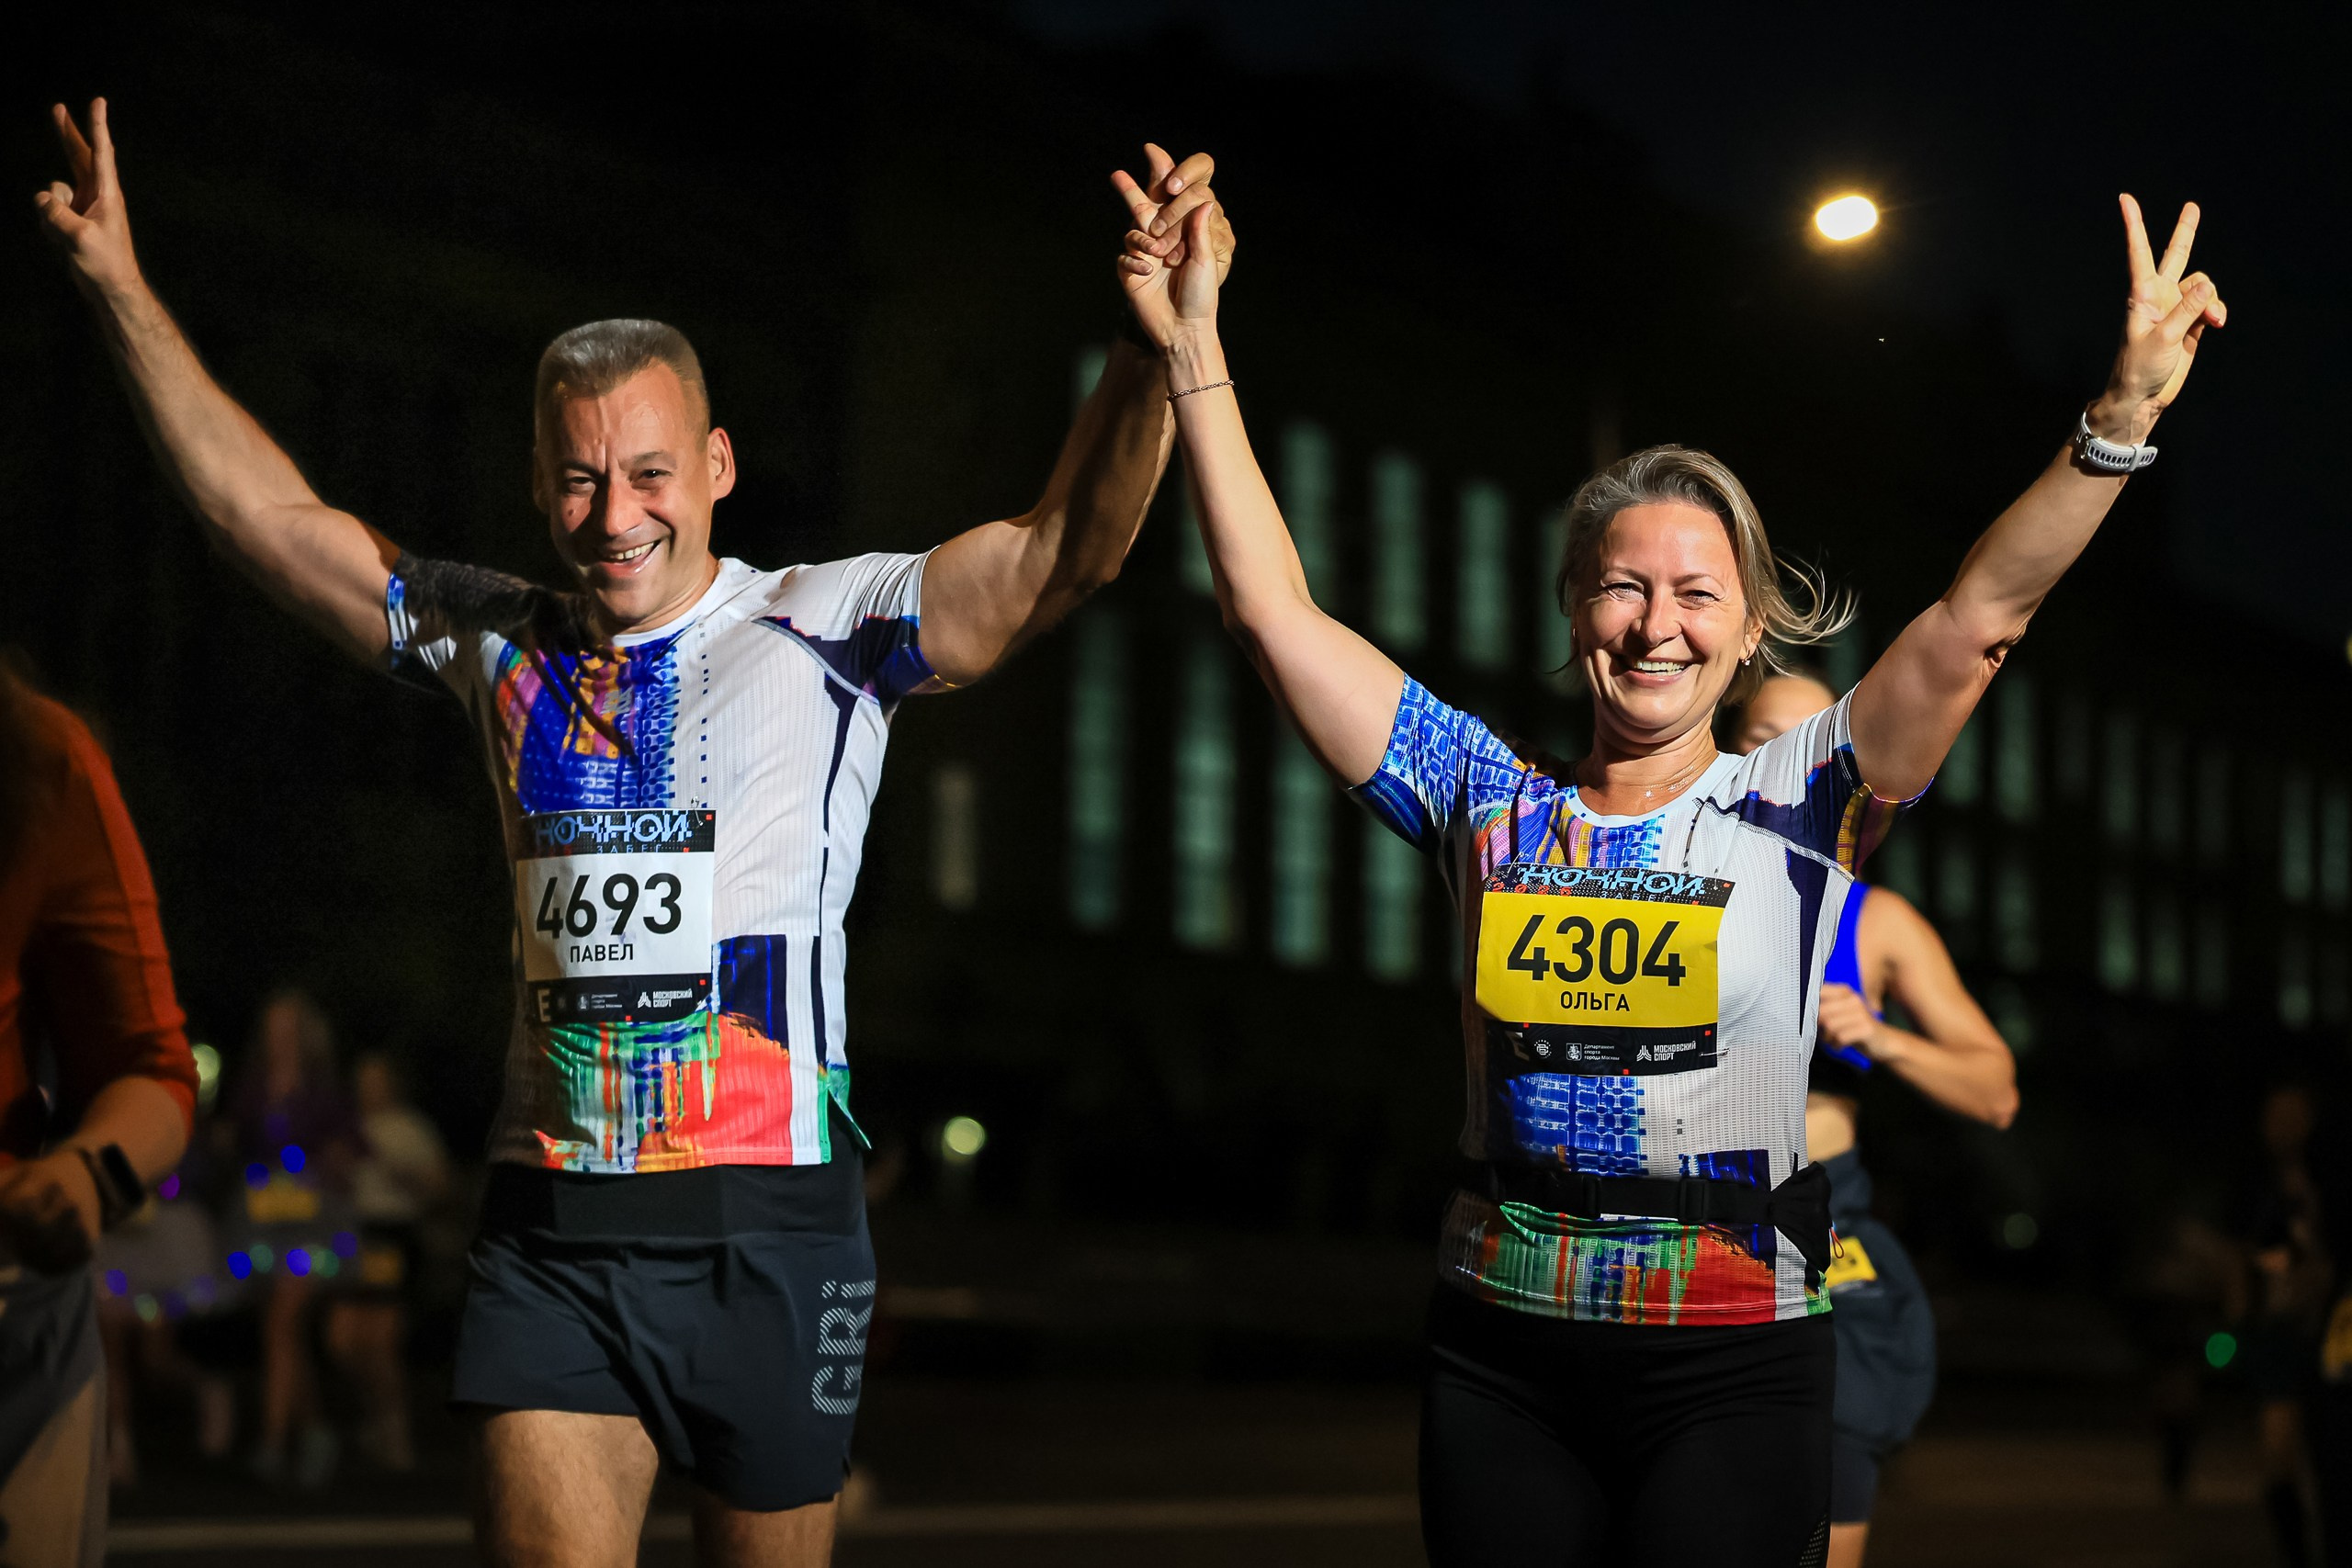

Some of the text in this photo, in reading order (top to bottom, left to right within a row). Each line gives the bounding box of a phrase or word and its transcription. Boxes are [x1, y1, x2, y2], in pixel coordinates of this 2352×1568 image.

[536, 810, 692, 845] НОЧНОЙ
[596, 845, 661, 853] ЗАБЕГ
[1518, 864, 1705, 897] НОЧНОЙ
[1600, 891, 1670, 903] ЗАБЕГ
[537, 873, 682, 939] 4693
[570, 943, 634, 963] ПАВЕЛ
[1507, 914, 1687, 987] 4304
[652, 988, 693, 1000] МОСКОВСКИЙ
[1560, 990, 1630, 1011] ОЛЬГА
[652, 998, 672, 1009] СПОРТ
[1654, 1041, 1697, 1054] МОСКОВСКИЙ
[1654, 1053, 1675, 1062] СПОРТ
